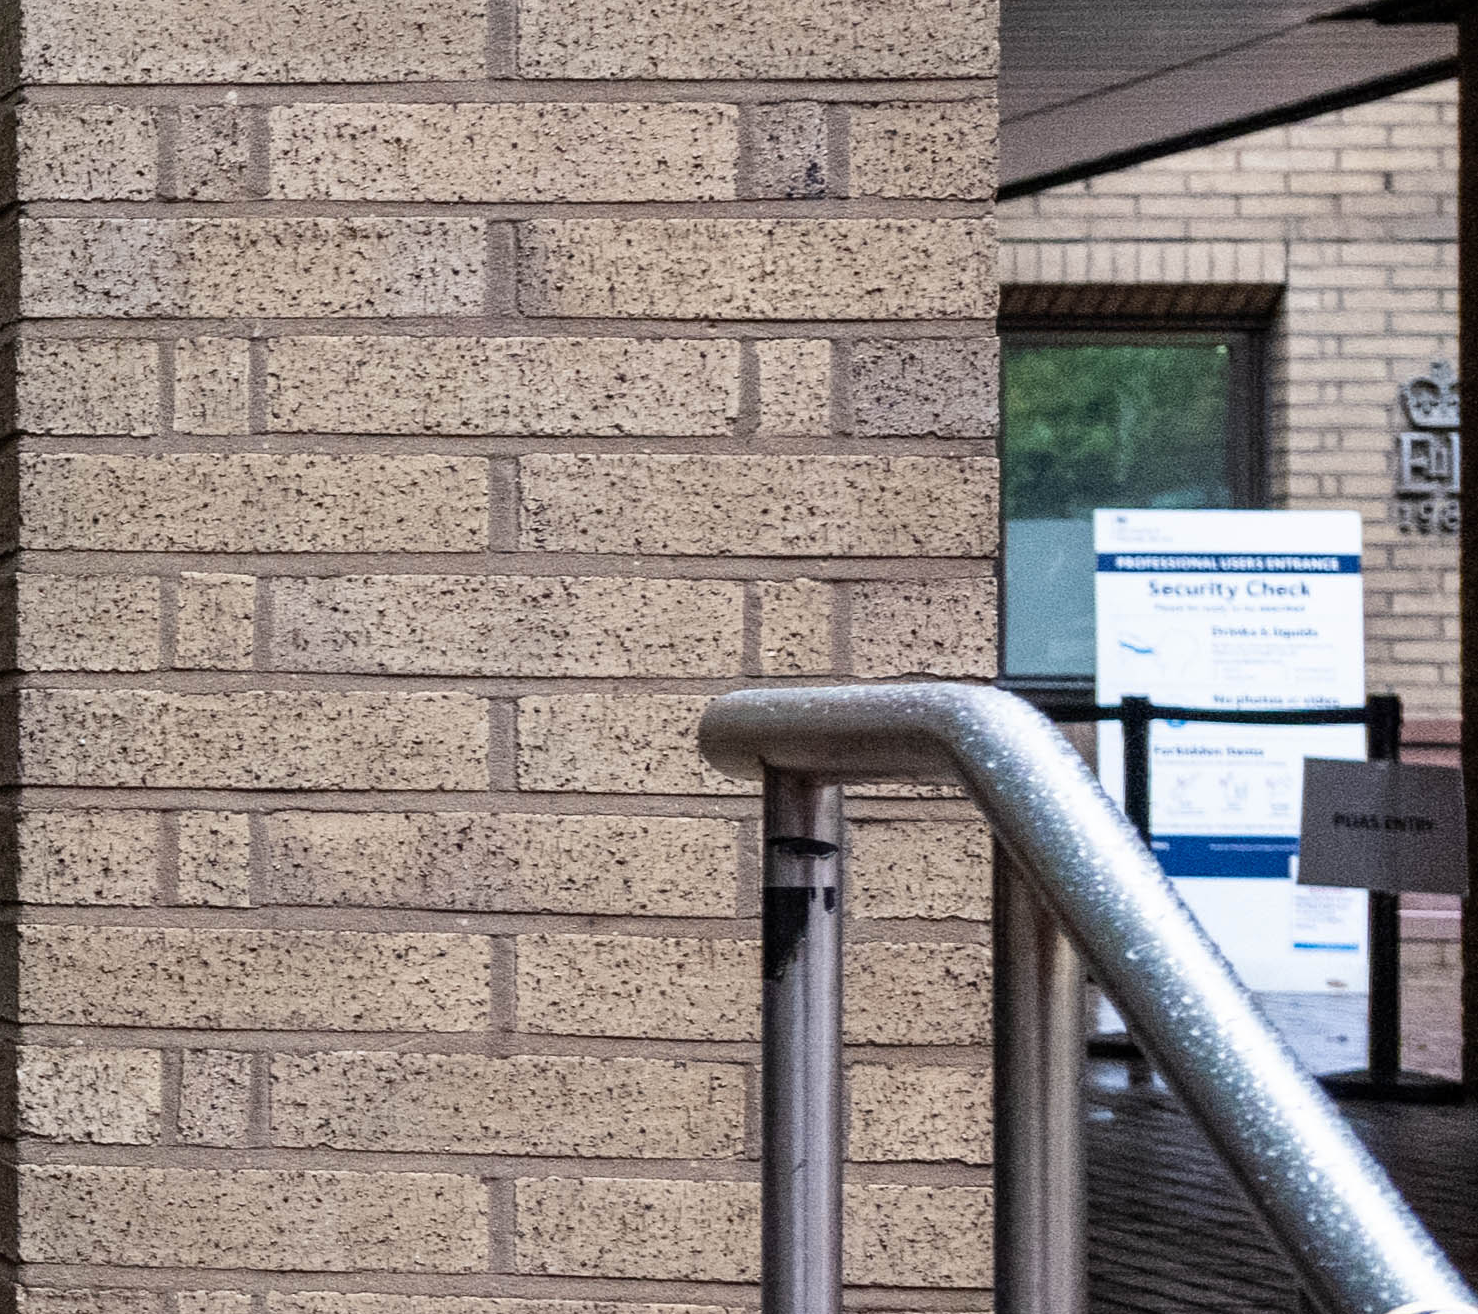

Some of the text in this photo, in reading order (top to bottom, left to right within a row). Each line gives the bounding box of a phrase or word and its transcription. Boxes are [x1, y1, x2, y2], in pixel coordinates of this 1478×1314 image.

[1115, 555, 1340, 573] PROFESSIONAL USERS ENTRANCE
[1149, 579, 1310, 600] Security Check
